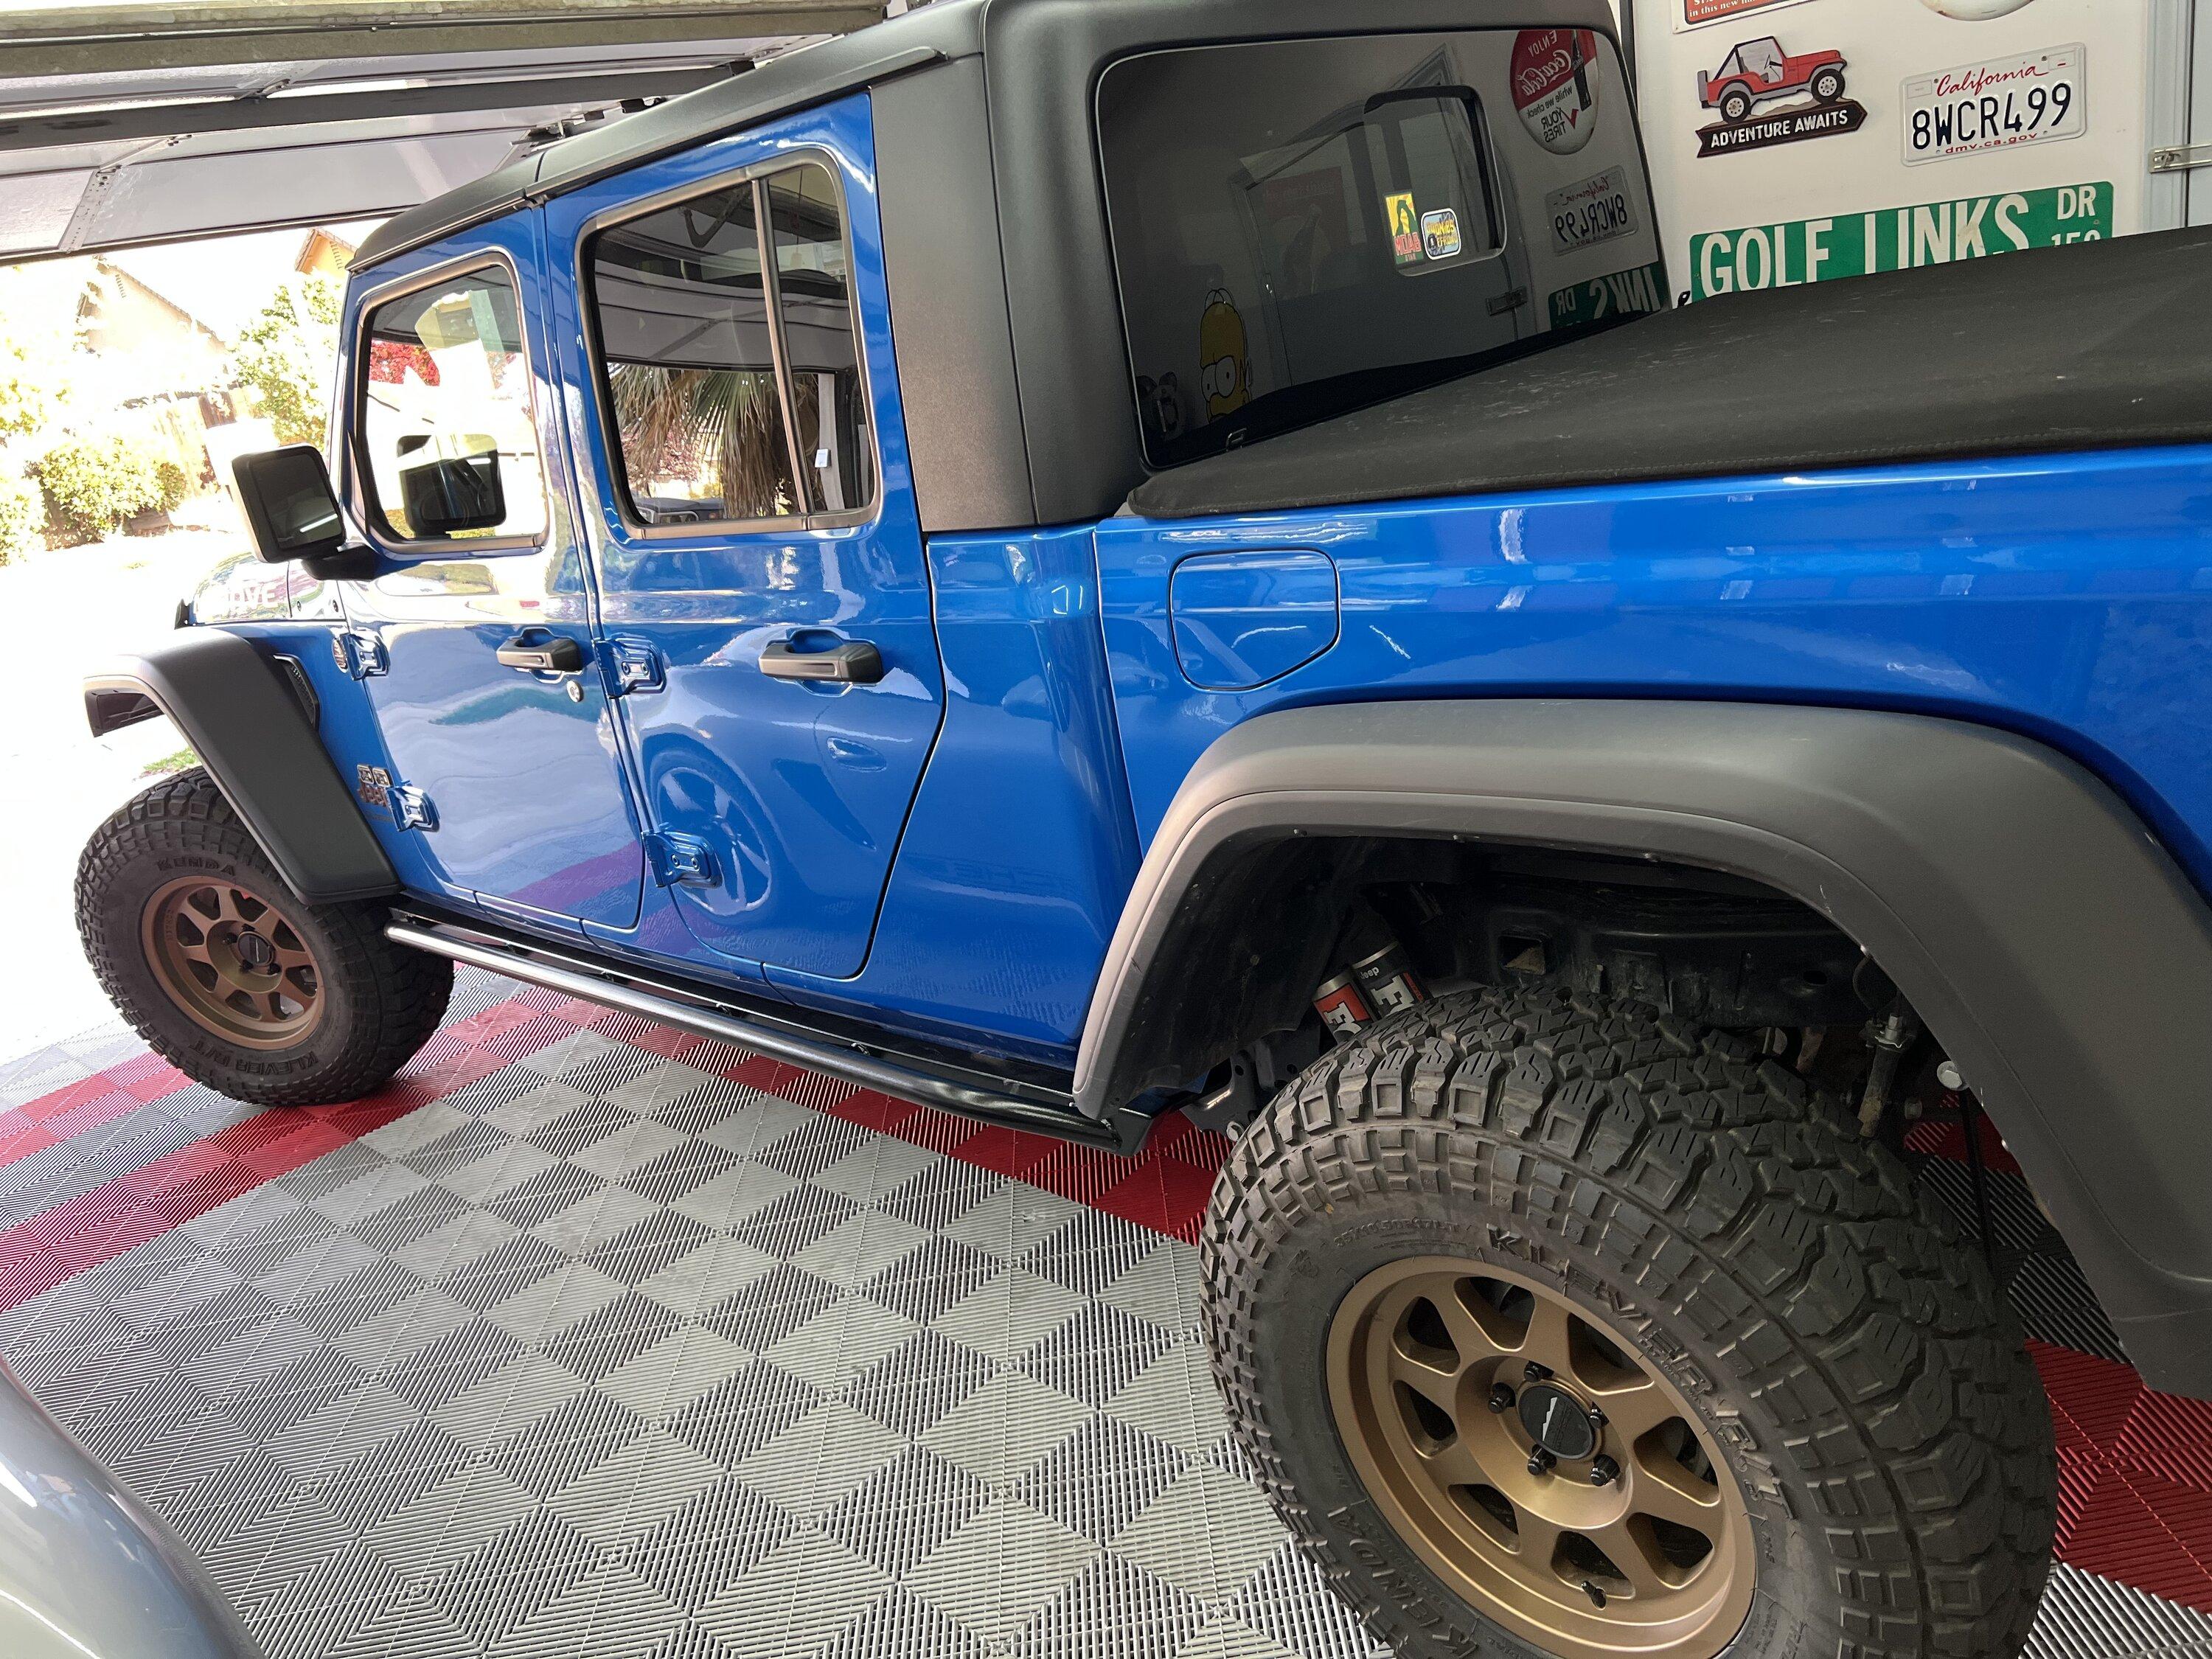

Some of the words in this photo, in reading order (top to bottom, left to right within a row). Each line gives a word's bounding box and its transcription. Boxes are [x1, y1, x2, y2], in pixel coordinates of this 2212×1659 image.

[1701, 5, 1718, 15] this
[1936, 61, 2049, 97] California
[1711, 119, 1791, 148] ADVENTURE
[1795, 109, 1848, 133] AWAITS
[1912, 82, 2072, 150] 8WCR499
[1945, 133, 2038, 154] dmv.ca.gov
[1394, 232, 1422, 257] MOAB
[1700, 218, 1834, 298] GOLF
[1864, 194, 2030, 274] LINKS
[2057, 186, 2097, 220] DR
[157, 855, 236, 877] KENDA
[1360, 967, 1380, 980] Jeep
[1486, 1223, 1714, 1393] KLEVER
